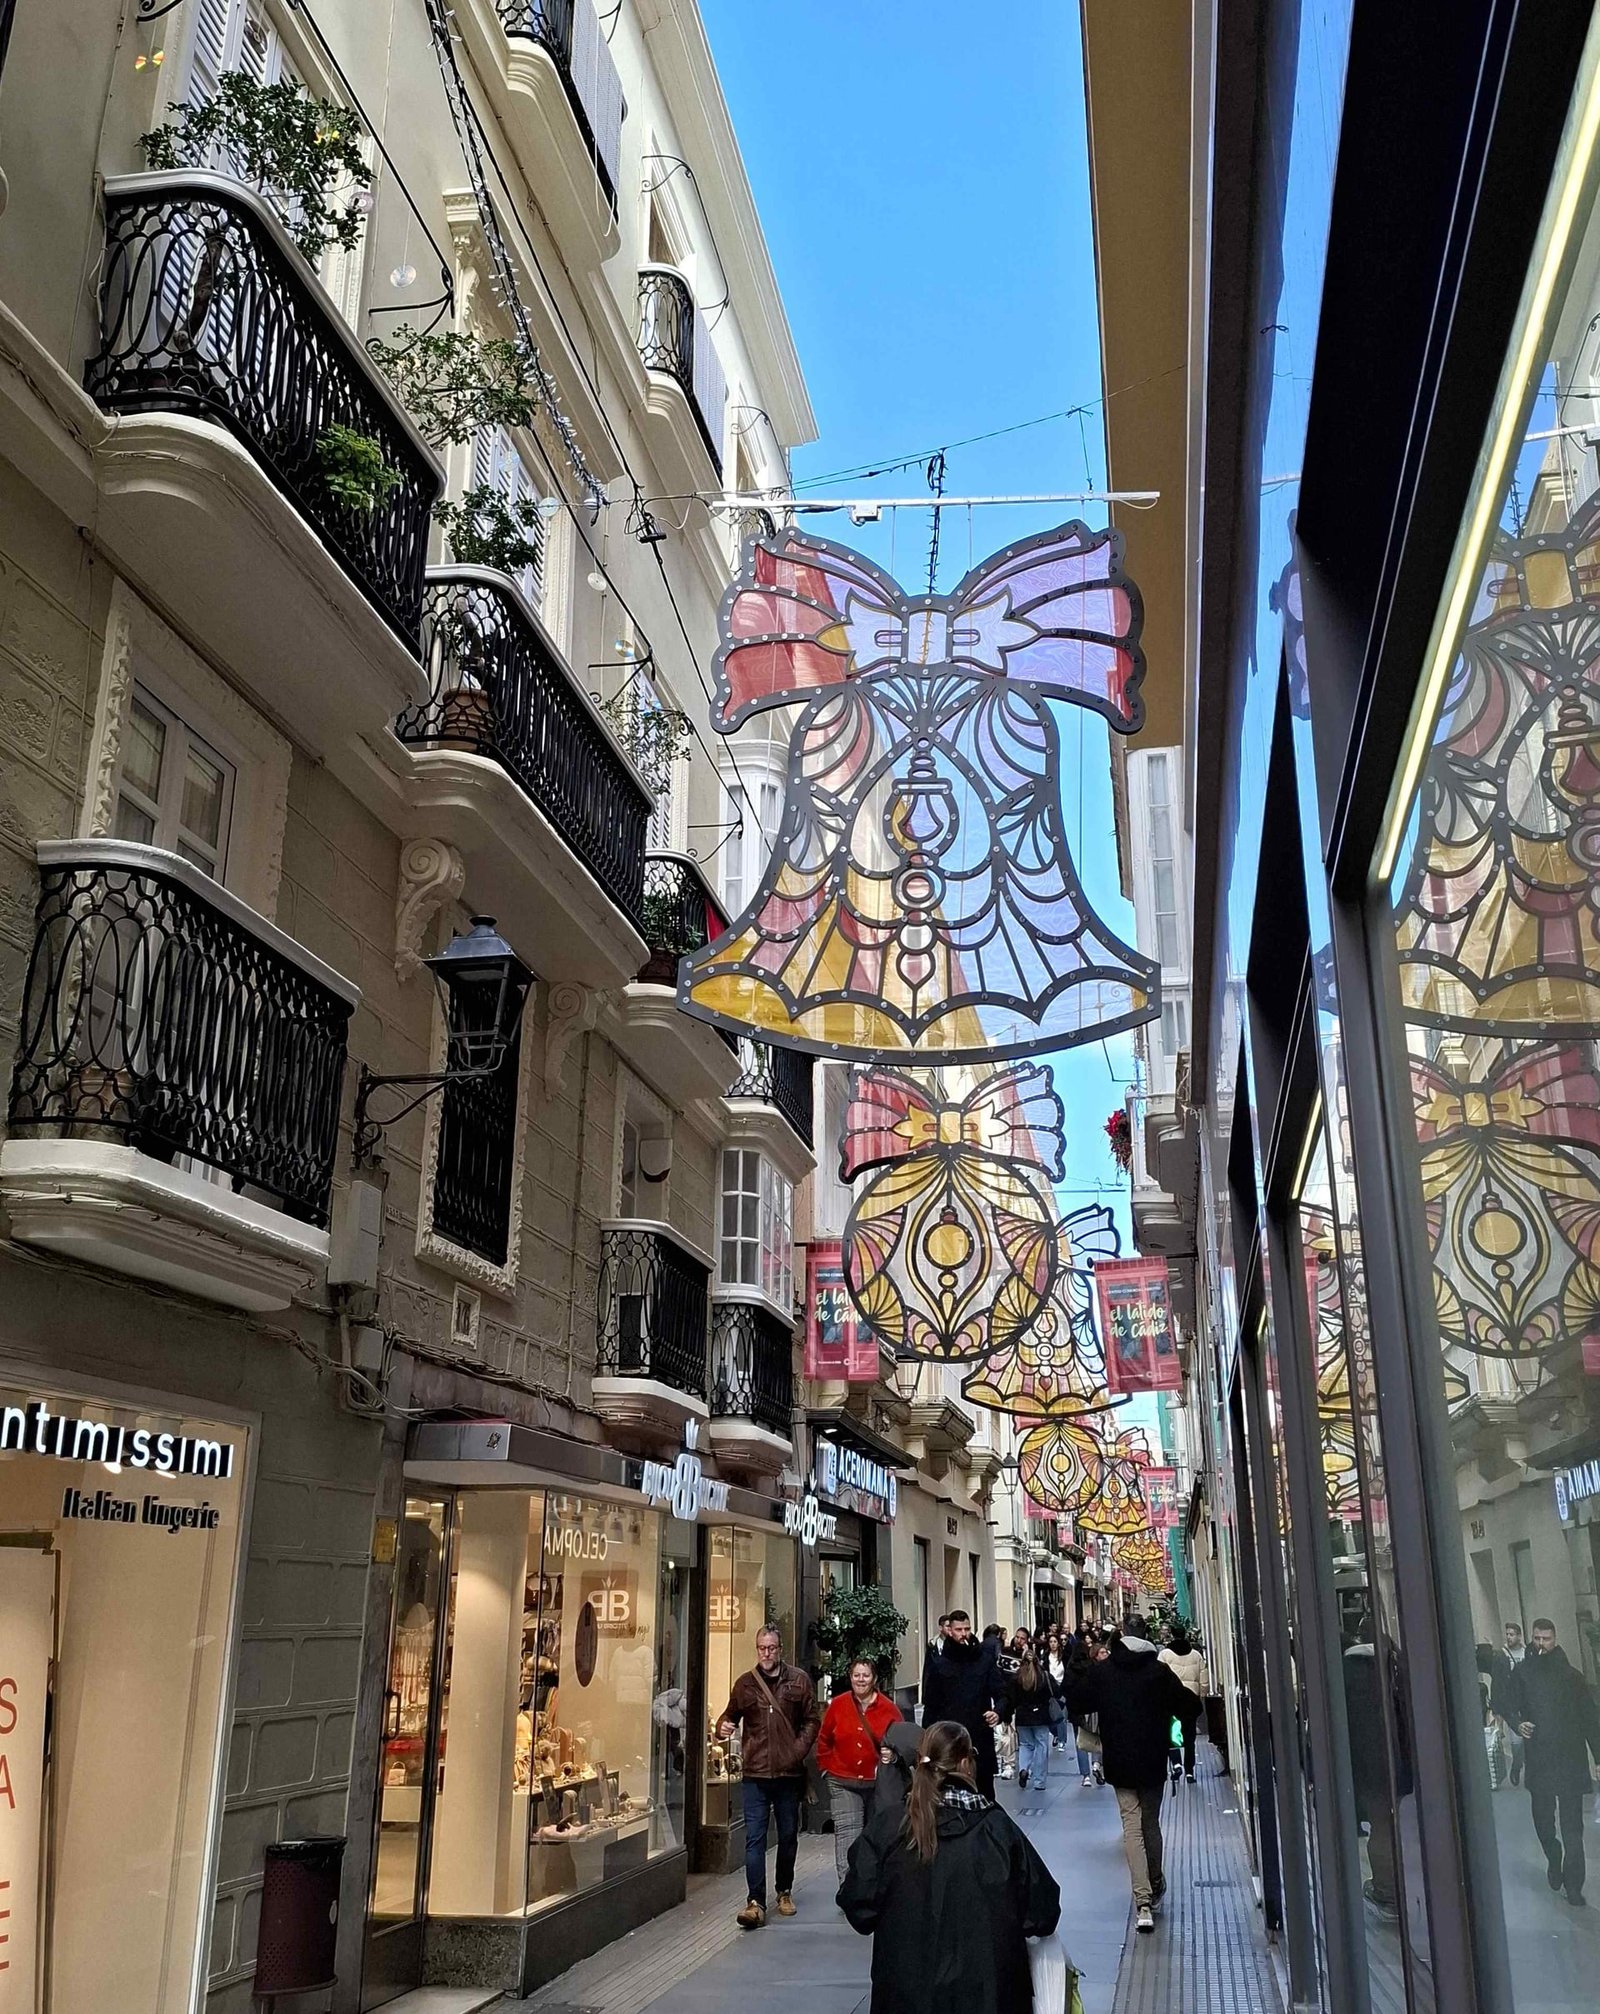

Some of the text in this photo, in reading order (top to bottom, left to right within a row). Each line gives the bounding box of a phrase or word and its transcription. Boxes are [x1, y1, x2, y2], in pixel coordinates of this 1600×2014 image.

[814, 1307, 831, 1322] de
[1127, 1300, 1166, 1320] latido
[1110, 1320, 1169, 1338] de Cádiz
[62, 1487, 220, 1535] Italian lingerie
[785, 1502, 804, 1536] BIJOU
